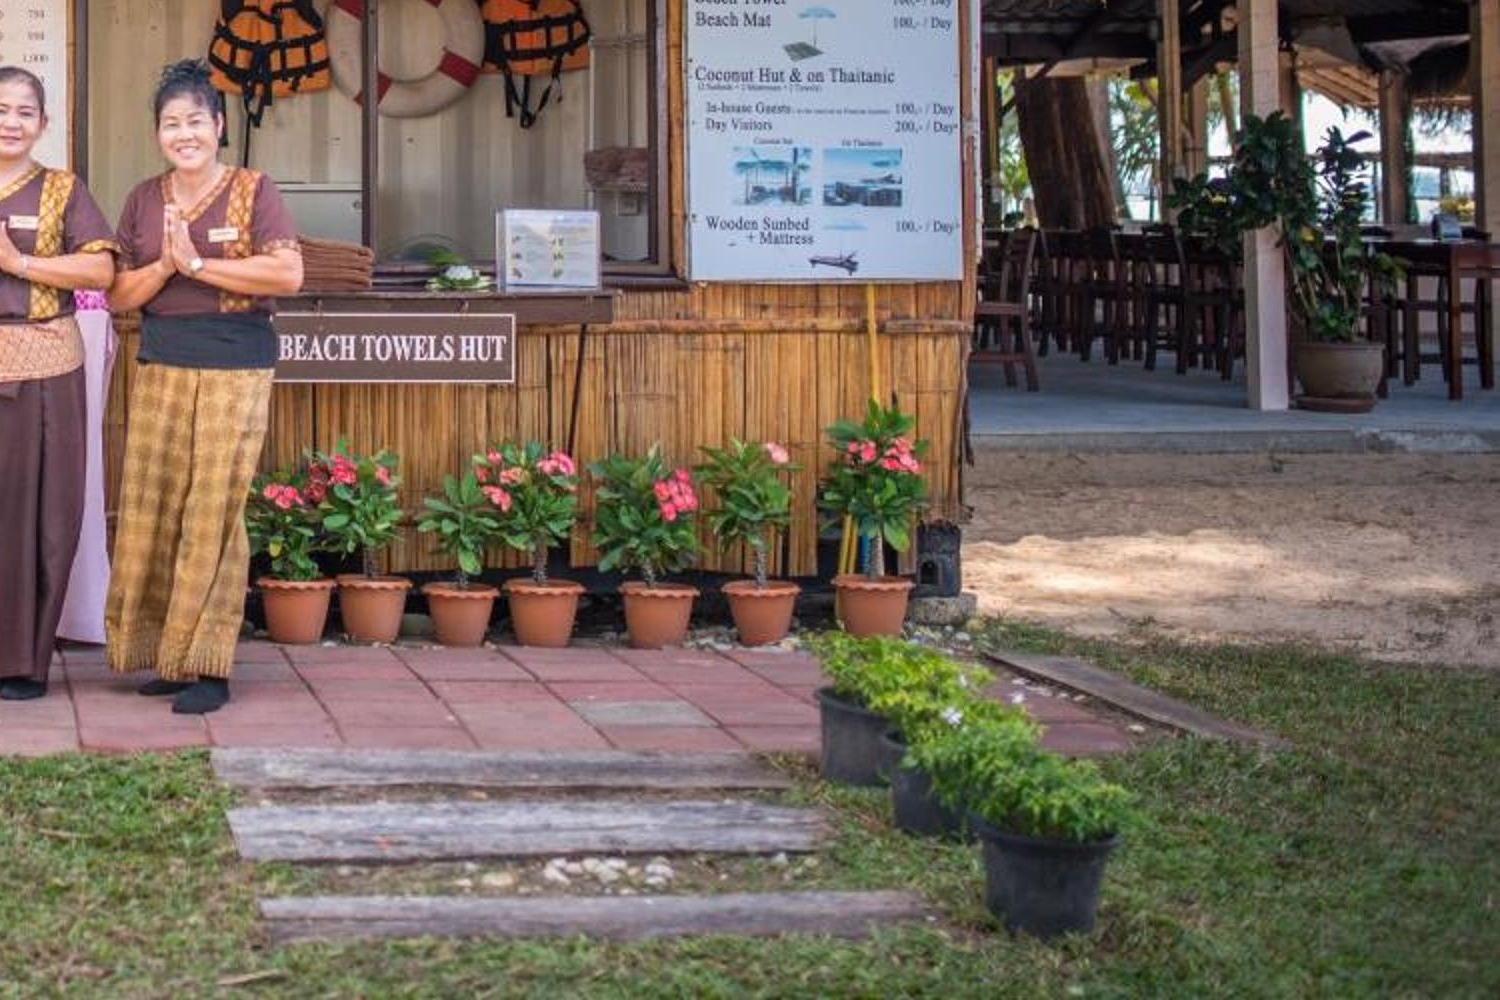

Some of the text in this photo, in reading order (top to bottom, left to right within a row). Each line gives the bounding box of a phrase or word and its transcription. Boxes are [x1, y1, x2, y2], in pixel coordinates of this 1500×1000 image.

[695, 11, 771, 27] Beach Mat
[931, 16, 952, 32] Day
[695, 66, 895, 84] Coconut Hut & on Thaitanic
[755, 101, 791, 114] Guests
[932, 103, 954, 117] Day
[706, 118, 773, 133] Day Visitors
[932, 121, 955, 135] Day
[705, 215, 810, 231] Wooden Sunbed
[933, 220, 955, 235] Day
[759, 231, 815, 246] Mattress
[279, 334, 507, 362] BEACH TOWELS HUT
